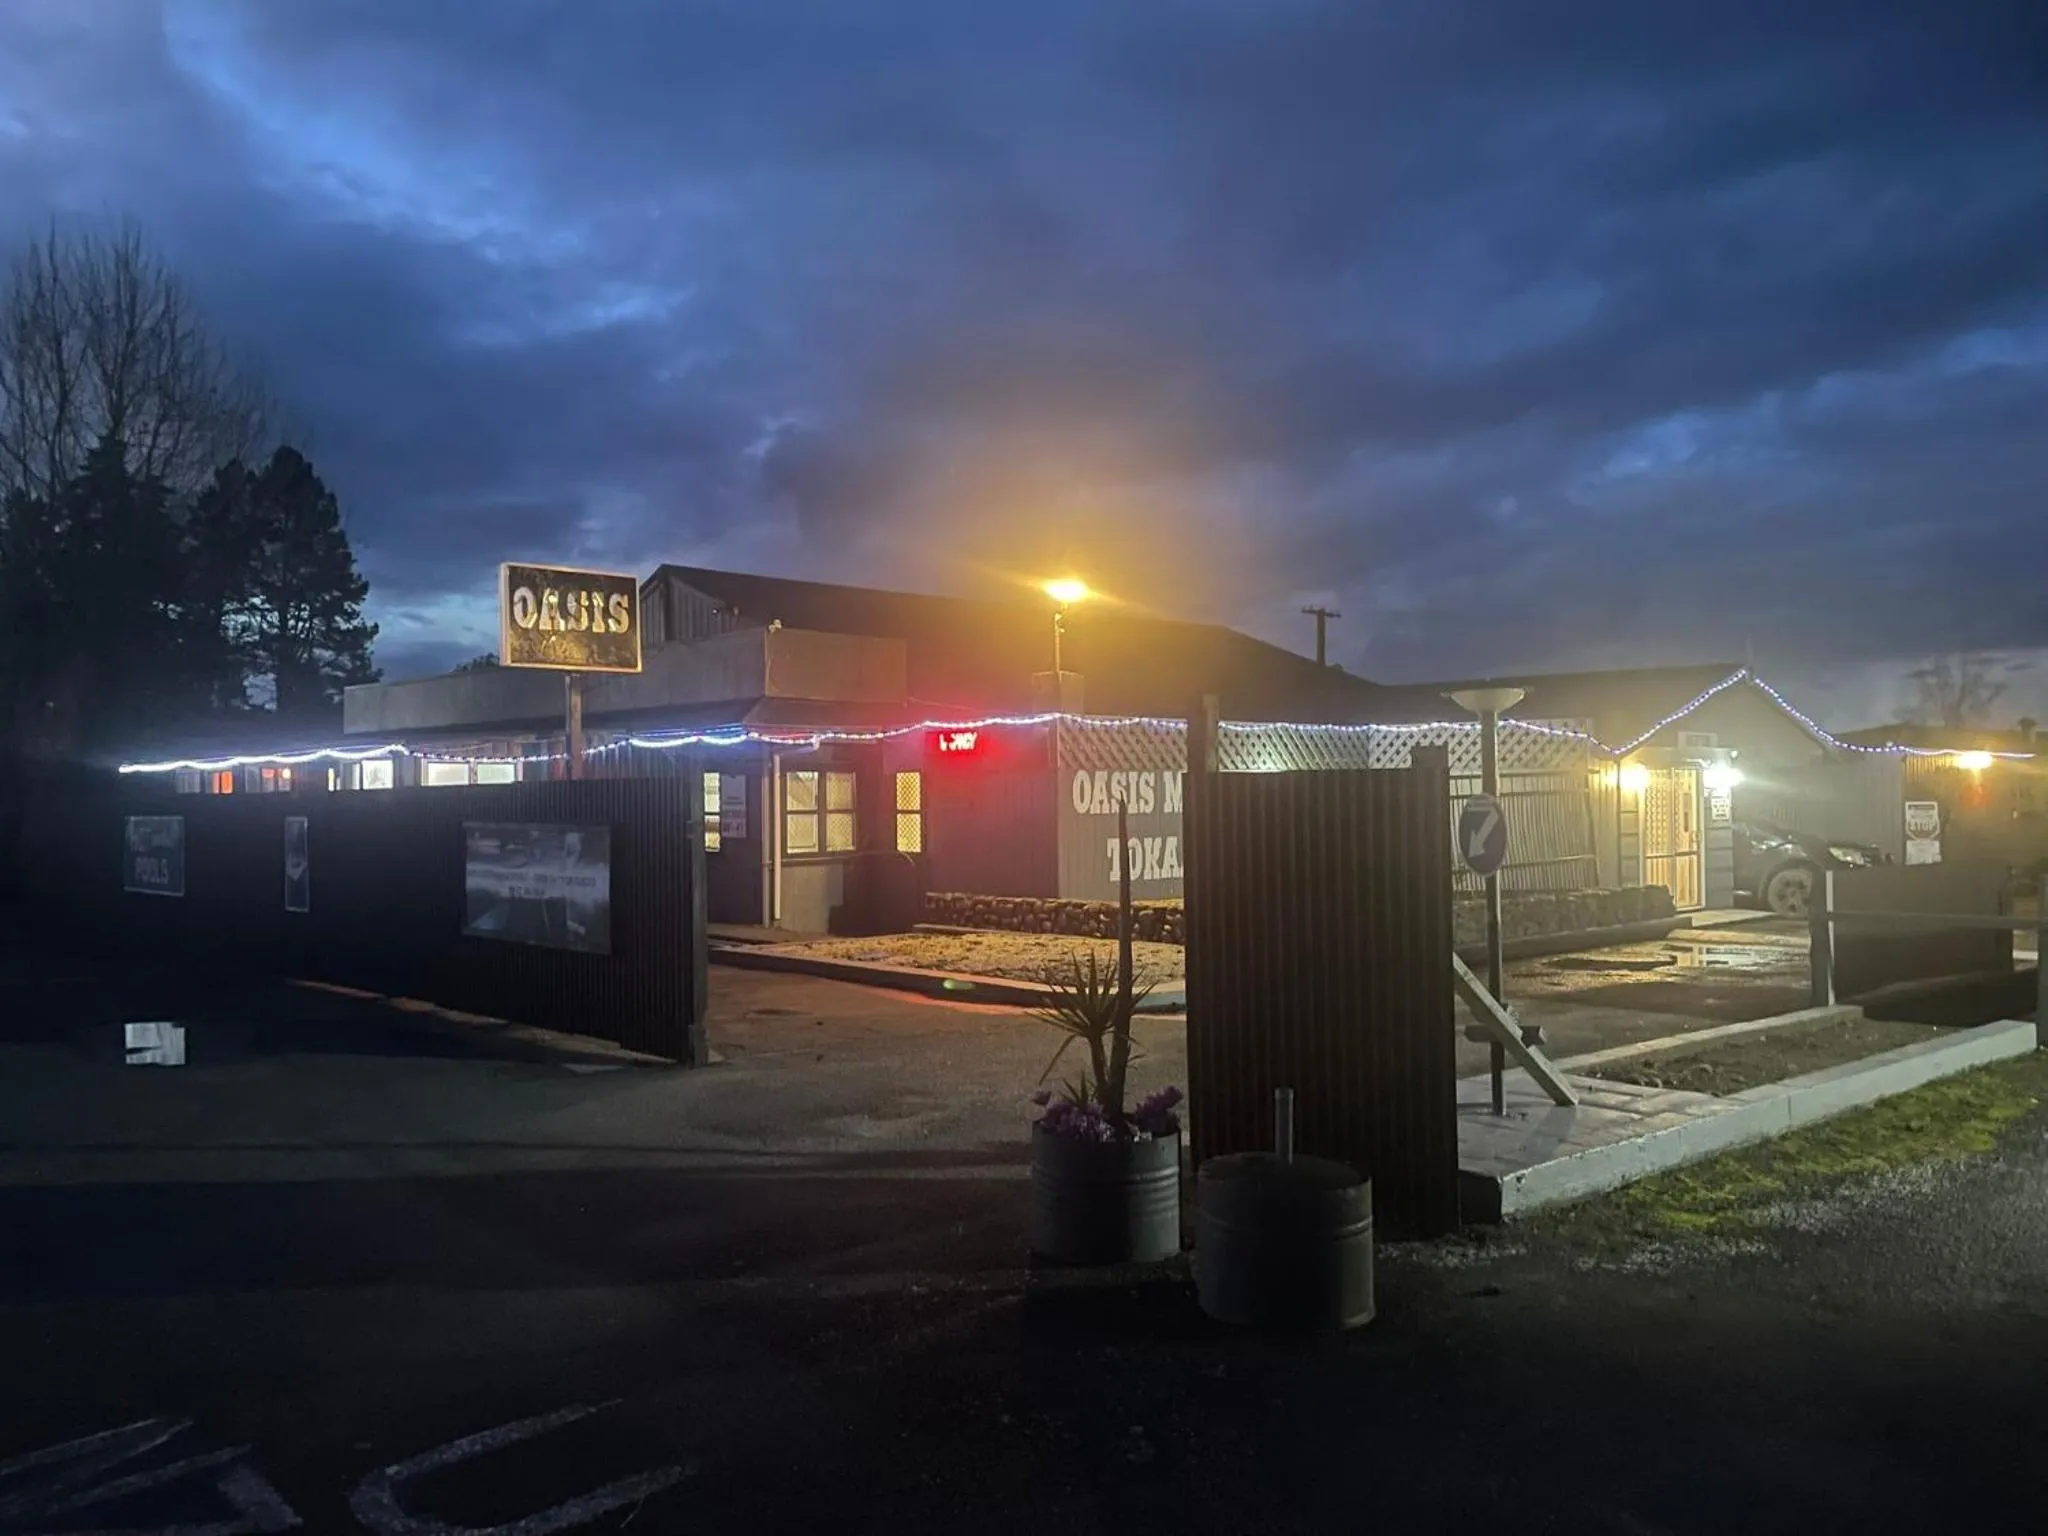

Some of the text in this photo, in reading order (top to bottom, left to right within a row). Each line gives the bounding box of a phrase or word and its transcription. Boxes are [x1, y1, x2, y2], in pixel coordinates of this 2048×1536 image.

[513, 586, 630, 634] OASIS
[1073, 769, 1155, 814] OASIS
[1909, 818, 1935, 831] STOP
[1106, 836, 1184, 883] TOKA
